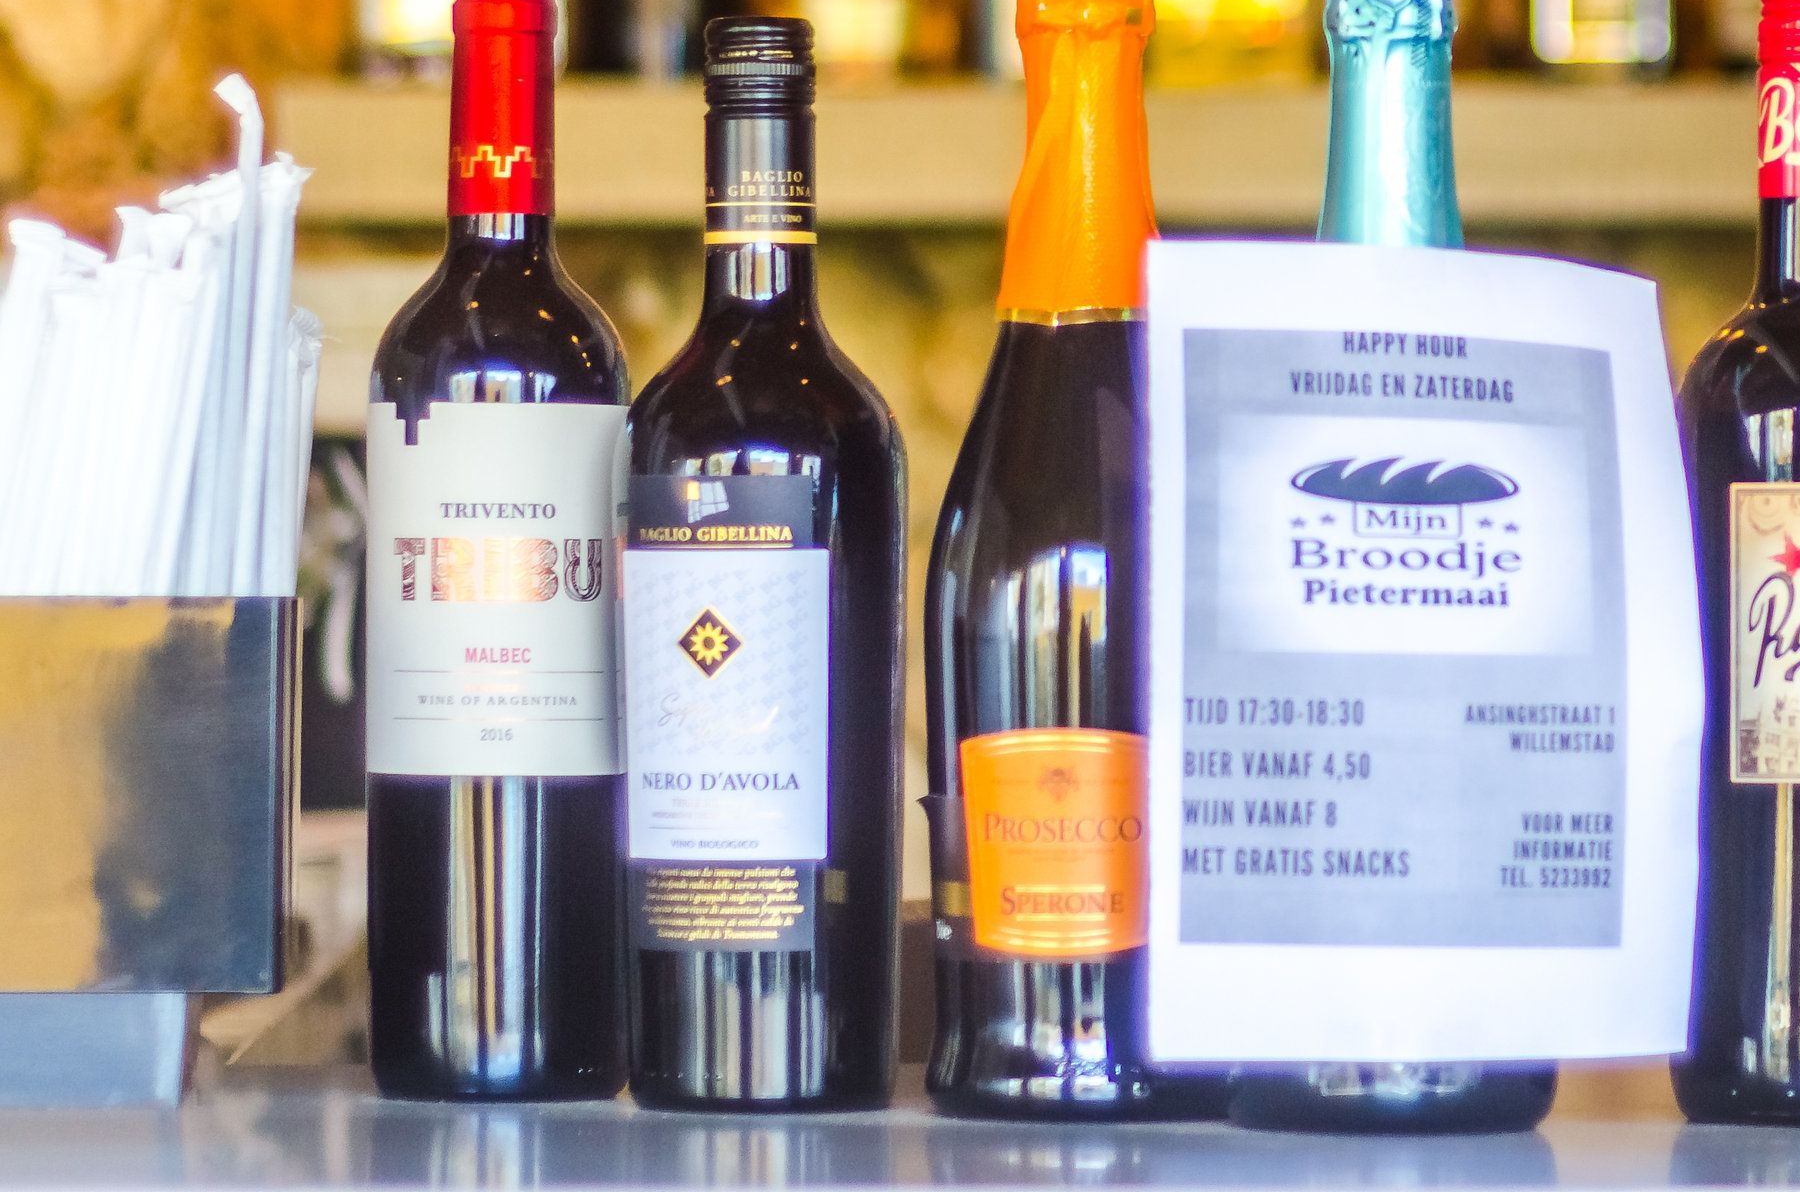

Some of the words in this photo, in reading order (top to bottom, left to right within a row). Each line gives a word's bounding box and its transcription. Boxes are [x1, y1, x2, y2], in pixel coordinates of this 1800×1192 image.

[741, 171, 804, 183] BAGLIO
[728, 185, 811, 197] GIBELLINA
[1342, 331, 1407, 356] HAPPY
[1416, 333, 1468, 359] HOUR
[1289, 371, 1373, 396] VRIJDAG
[1382, 374, 1406, 397] EN
[1414, 375, 1514, 403] ZATERDAG
[440, 503, 556, 519] TRIVENTO
[1365, 508, 1447, 534] Mijn
[640, 526, 692, 542] BAGLIO
[697, 526, 793, 542] GIBELLINA
[394, 537, 603, 602] TRIBU
[1290, 538, 1523, 578] Broodje
[1302, 579, 1510, 607] Pietermaai
[465, 648, 532, 663] MALBEC
[418, 695, 454, 706] WINE
[461, 695, 480, 706] OF
[487, 695, 578, 707] ARGENTINA
[1184, 698, 1228, 726] TIJD
[1238, 699, 1366, 727] 17:30-18:30
[480, 728, 513, 742] 2016
[1509, 732, 1616, 753] WILLEMSTAD
[1184, 751, 1233, 778] BIER
[1242, 752, 1314, 779] VANAF
[1322, 753, 1372, 781] 4,50
[642, 772, 692, 791] NERO
[700, 772, 801, 791] D'AVOLA
[1182, 800, 1234, 826] WIJN
[1244, 801, 1316, 827] VANAF
[1325, 801, 1337, 828] 8
[1521, 812, 1563, 834] VOOR
[1570, 812, 1614, 834] MEER
[983, 813, 1143, 843] PROSECCO
[1182, 847, 1225, 875] MET
[1234, 848, 1313, 876] GRATIS
[1322, 850, 1411, 878] SNACKS
[1513, 839, 1613, 861] INFORMATIE
[1001, 886, 1126, 915] SPERONE
